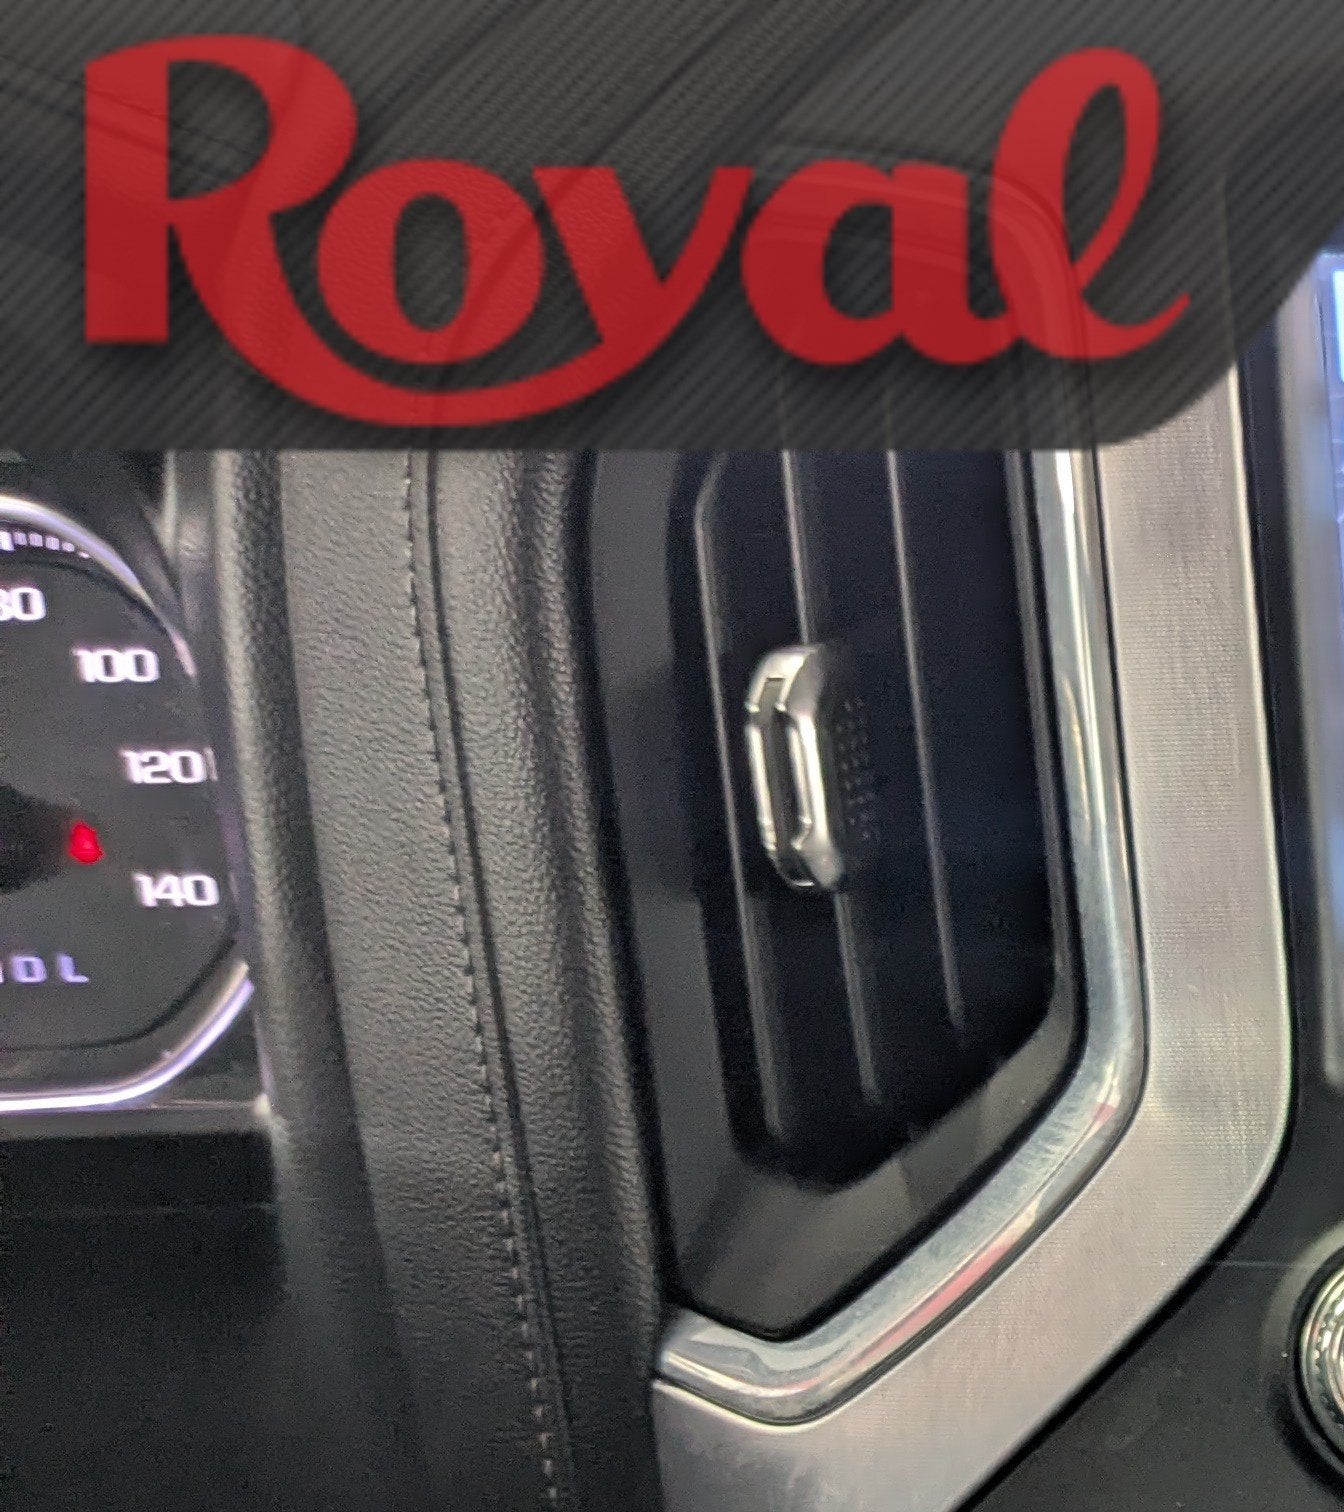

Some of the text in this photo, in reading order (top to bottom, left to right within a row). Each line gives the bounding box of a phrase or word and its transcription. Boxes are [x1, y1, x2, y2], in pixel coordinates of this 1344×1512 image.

[72, 648, 159, 683] 100
[120, 748, 205, 784] 120
[133, 873, 219, 908] 140
